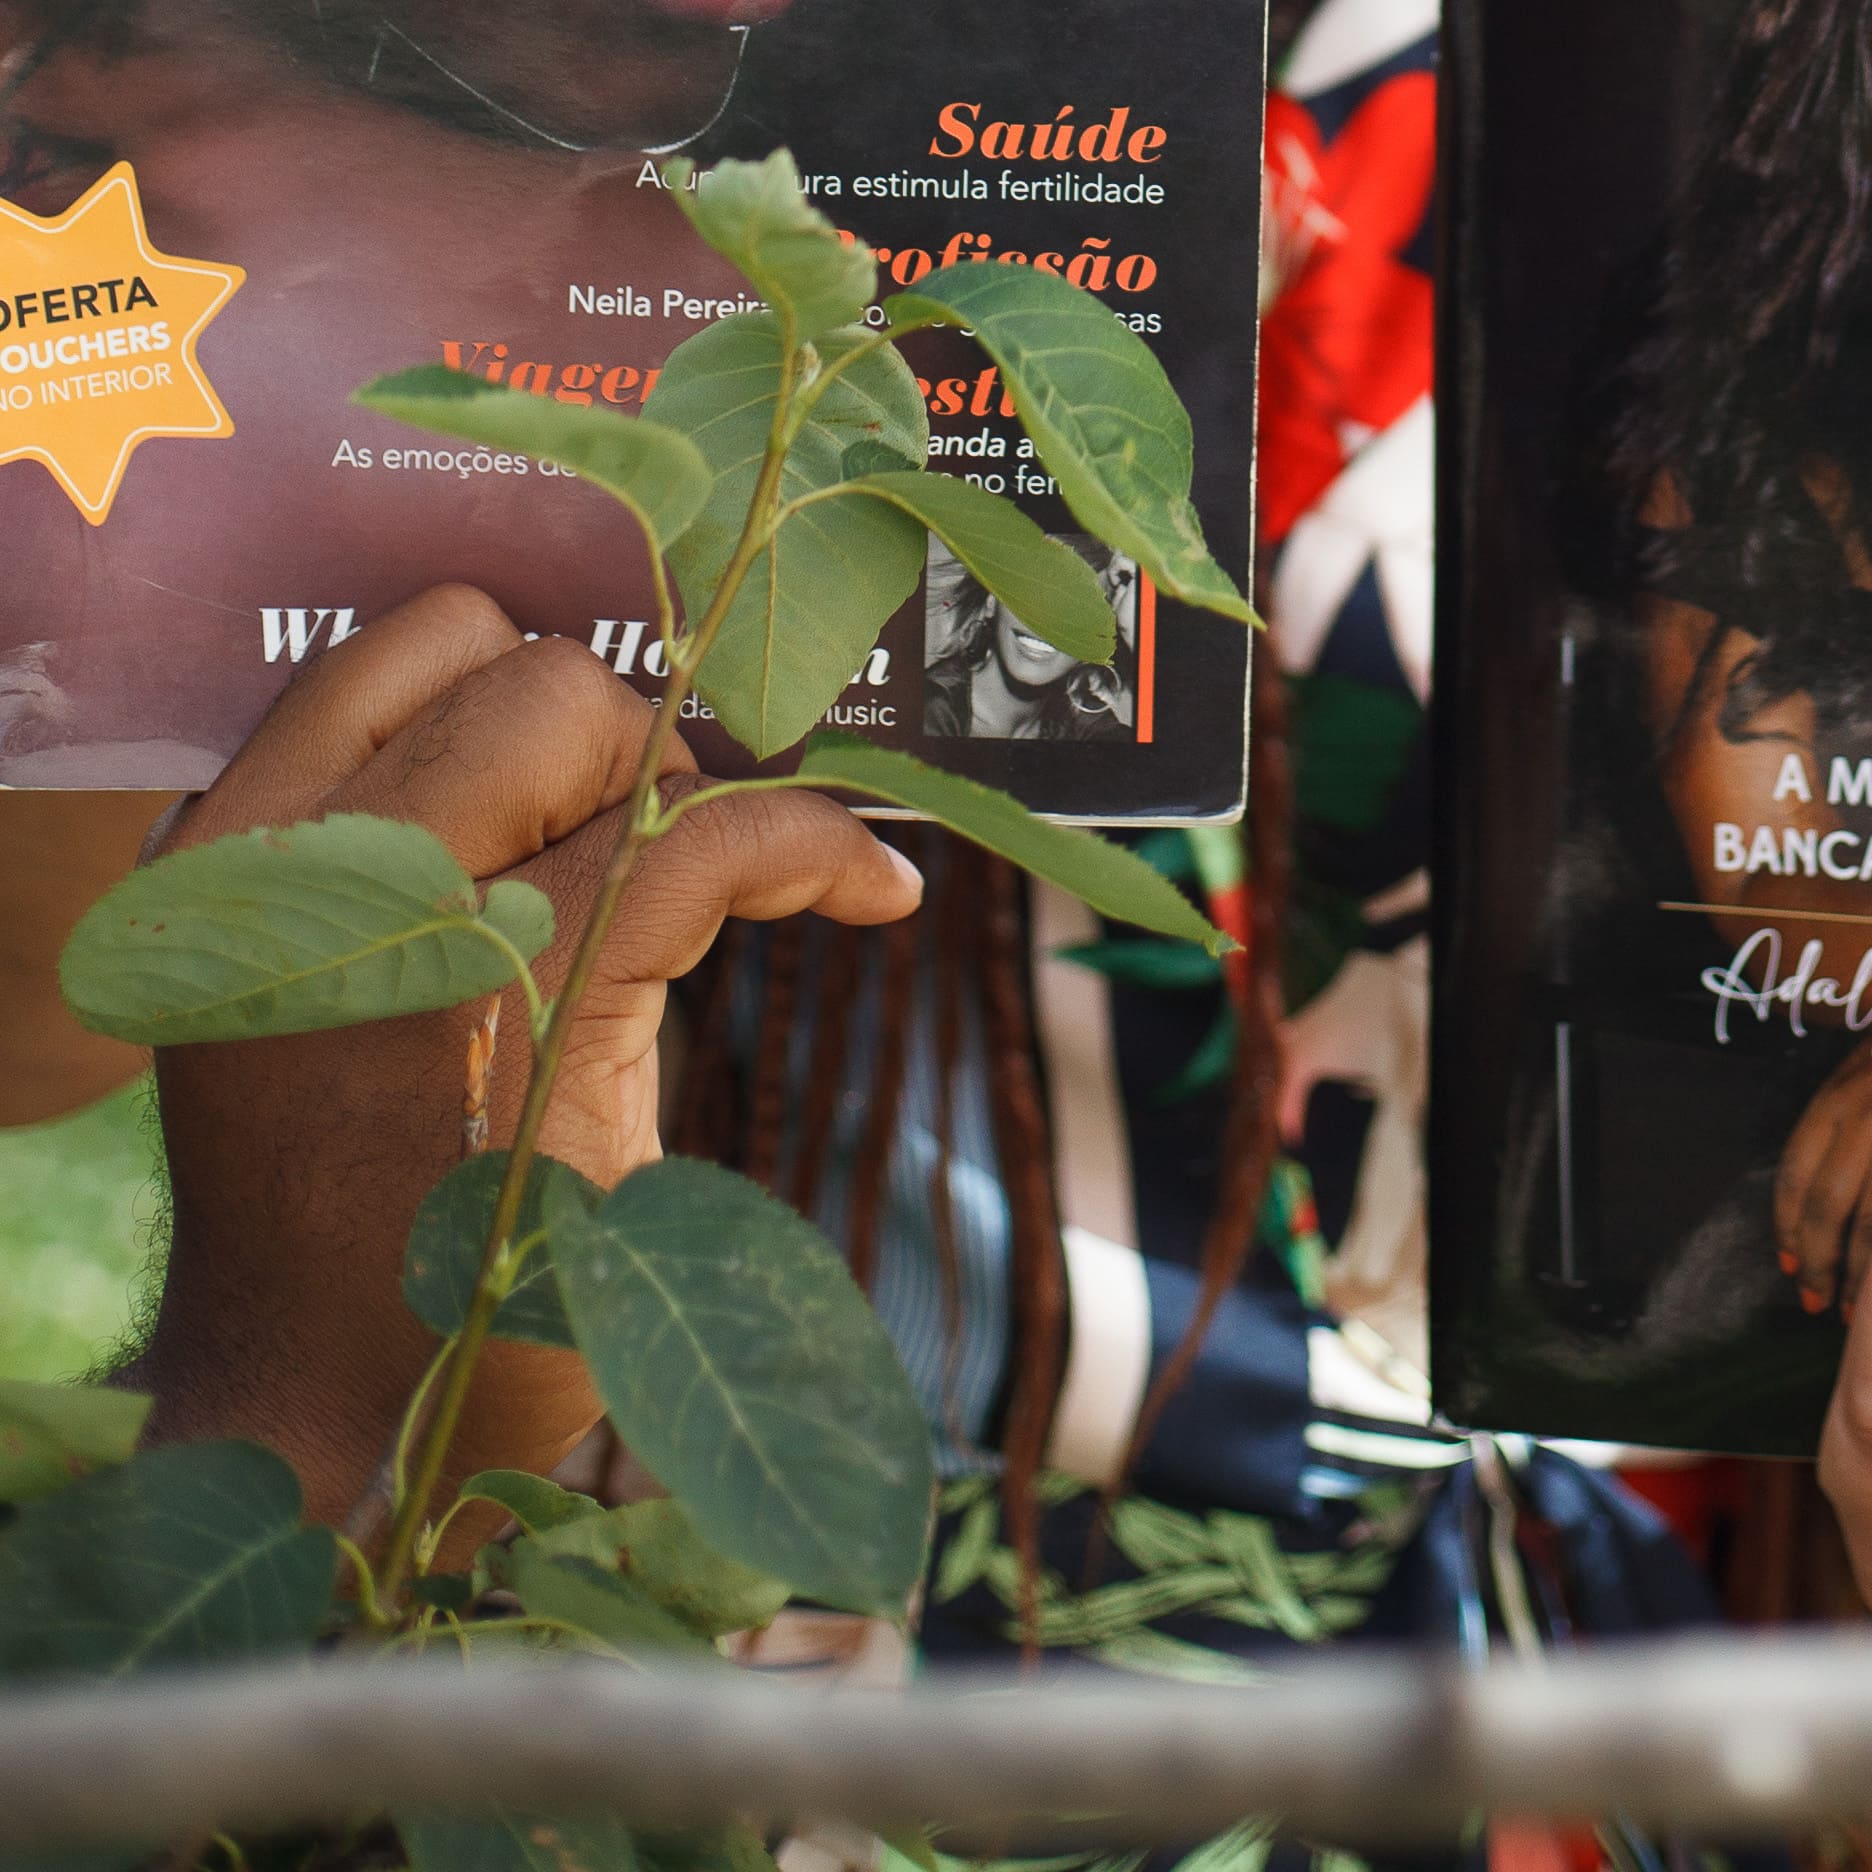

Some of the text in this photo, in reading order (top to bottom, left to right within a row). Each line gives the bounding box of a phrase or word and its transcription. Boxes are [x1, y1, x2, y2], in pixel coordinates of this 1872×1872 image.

[929, 102, 1167, 163] Saúde
[852, 169, 988, 200] estimula
[998, 169, 1165, 205] fertilidade
[569, 284, 651, 317] Neila
[0, 318, 173, 378] OUCHERS
[38, 360, 176, 408] INTERIOR
[331, 439, 373, 469] As
[382, 445, 529, 479] emoções
[1772, 753, 1810, 801] A
